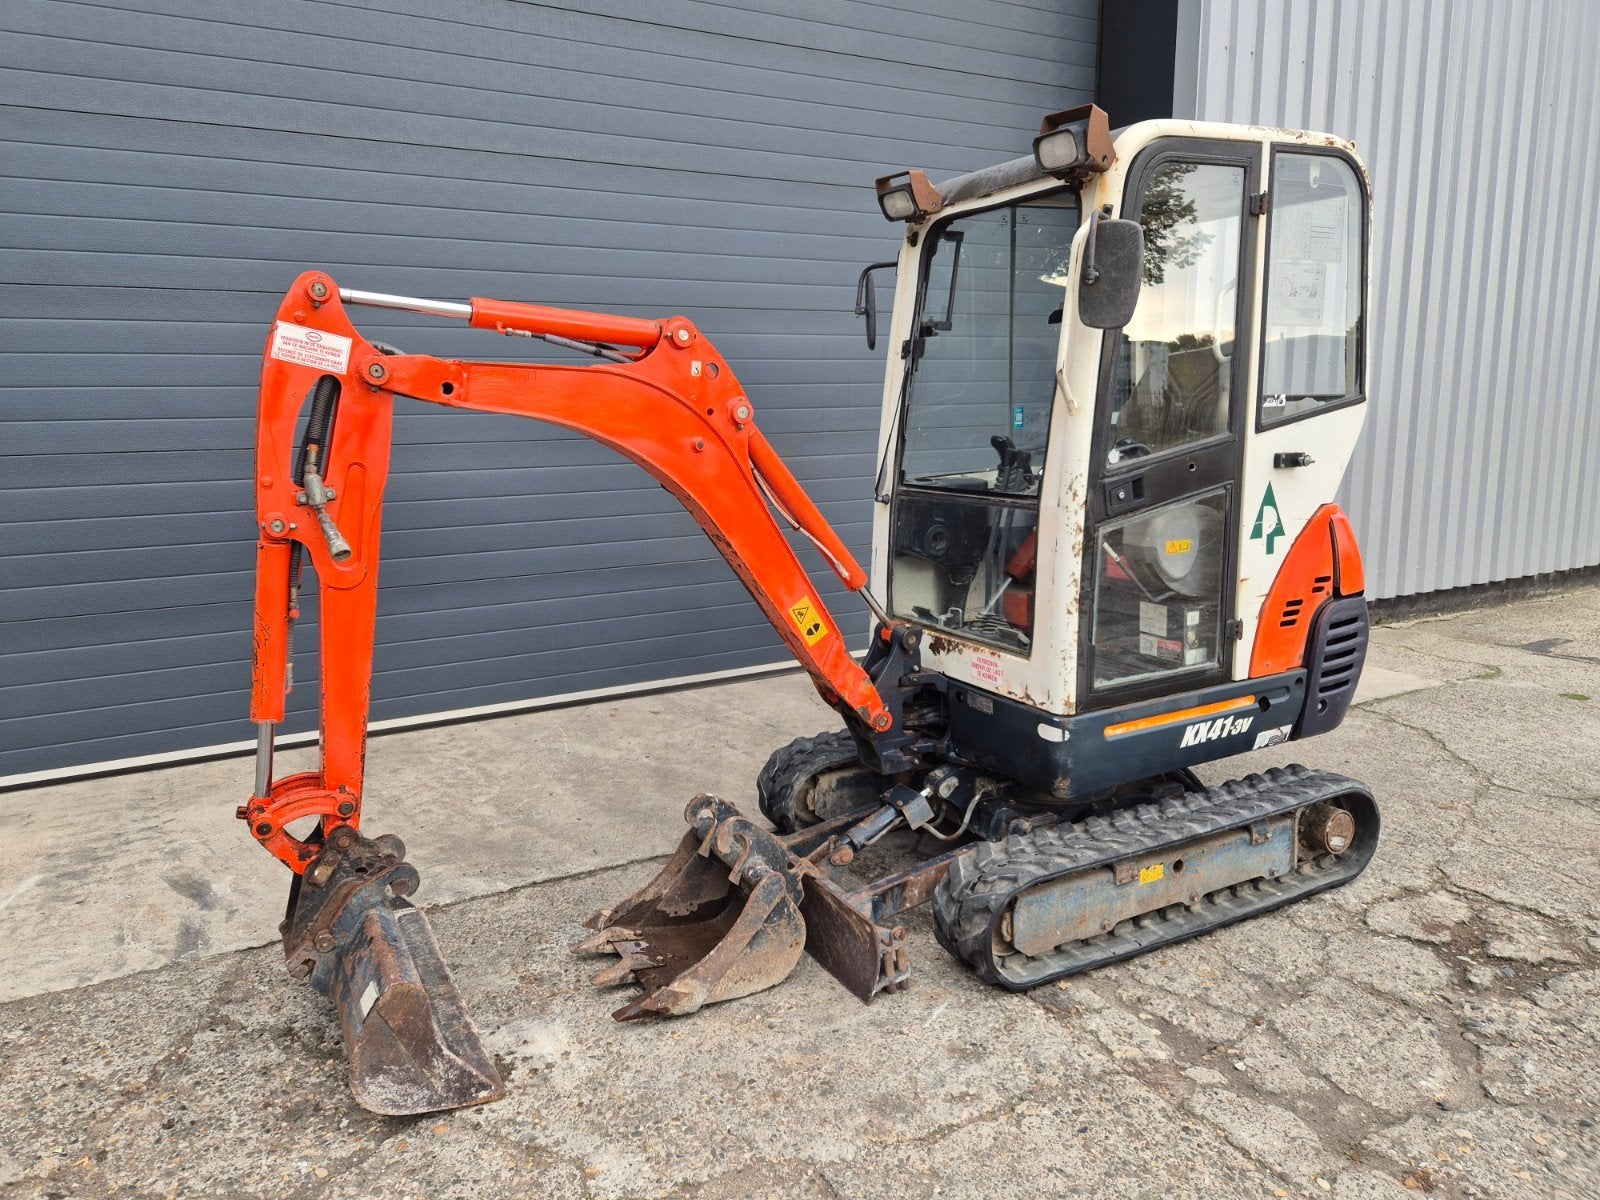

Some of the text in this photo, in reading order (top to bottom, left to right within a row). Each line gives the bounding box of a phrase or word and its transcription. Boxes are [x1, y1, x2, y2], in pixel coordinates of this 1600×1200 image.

[281, 335, 303, 344] VERBODEN
[972, 662, 985, 670] ONDER
[977, 657, 998, 668] VERBODEN
[982, 672, 997, 682] KOMEN
[1180, 716, 1254, 748] KX41-3V
